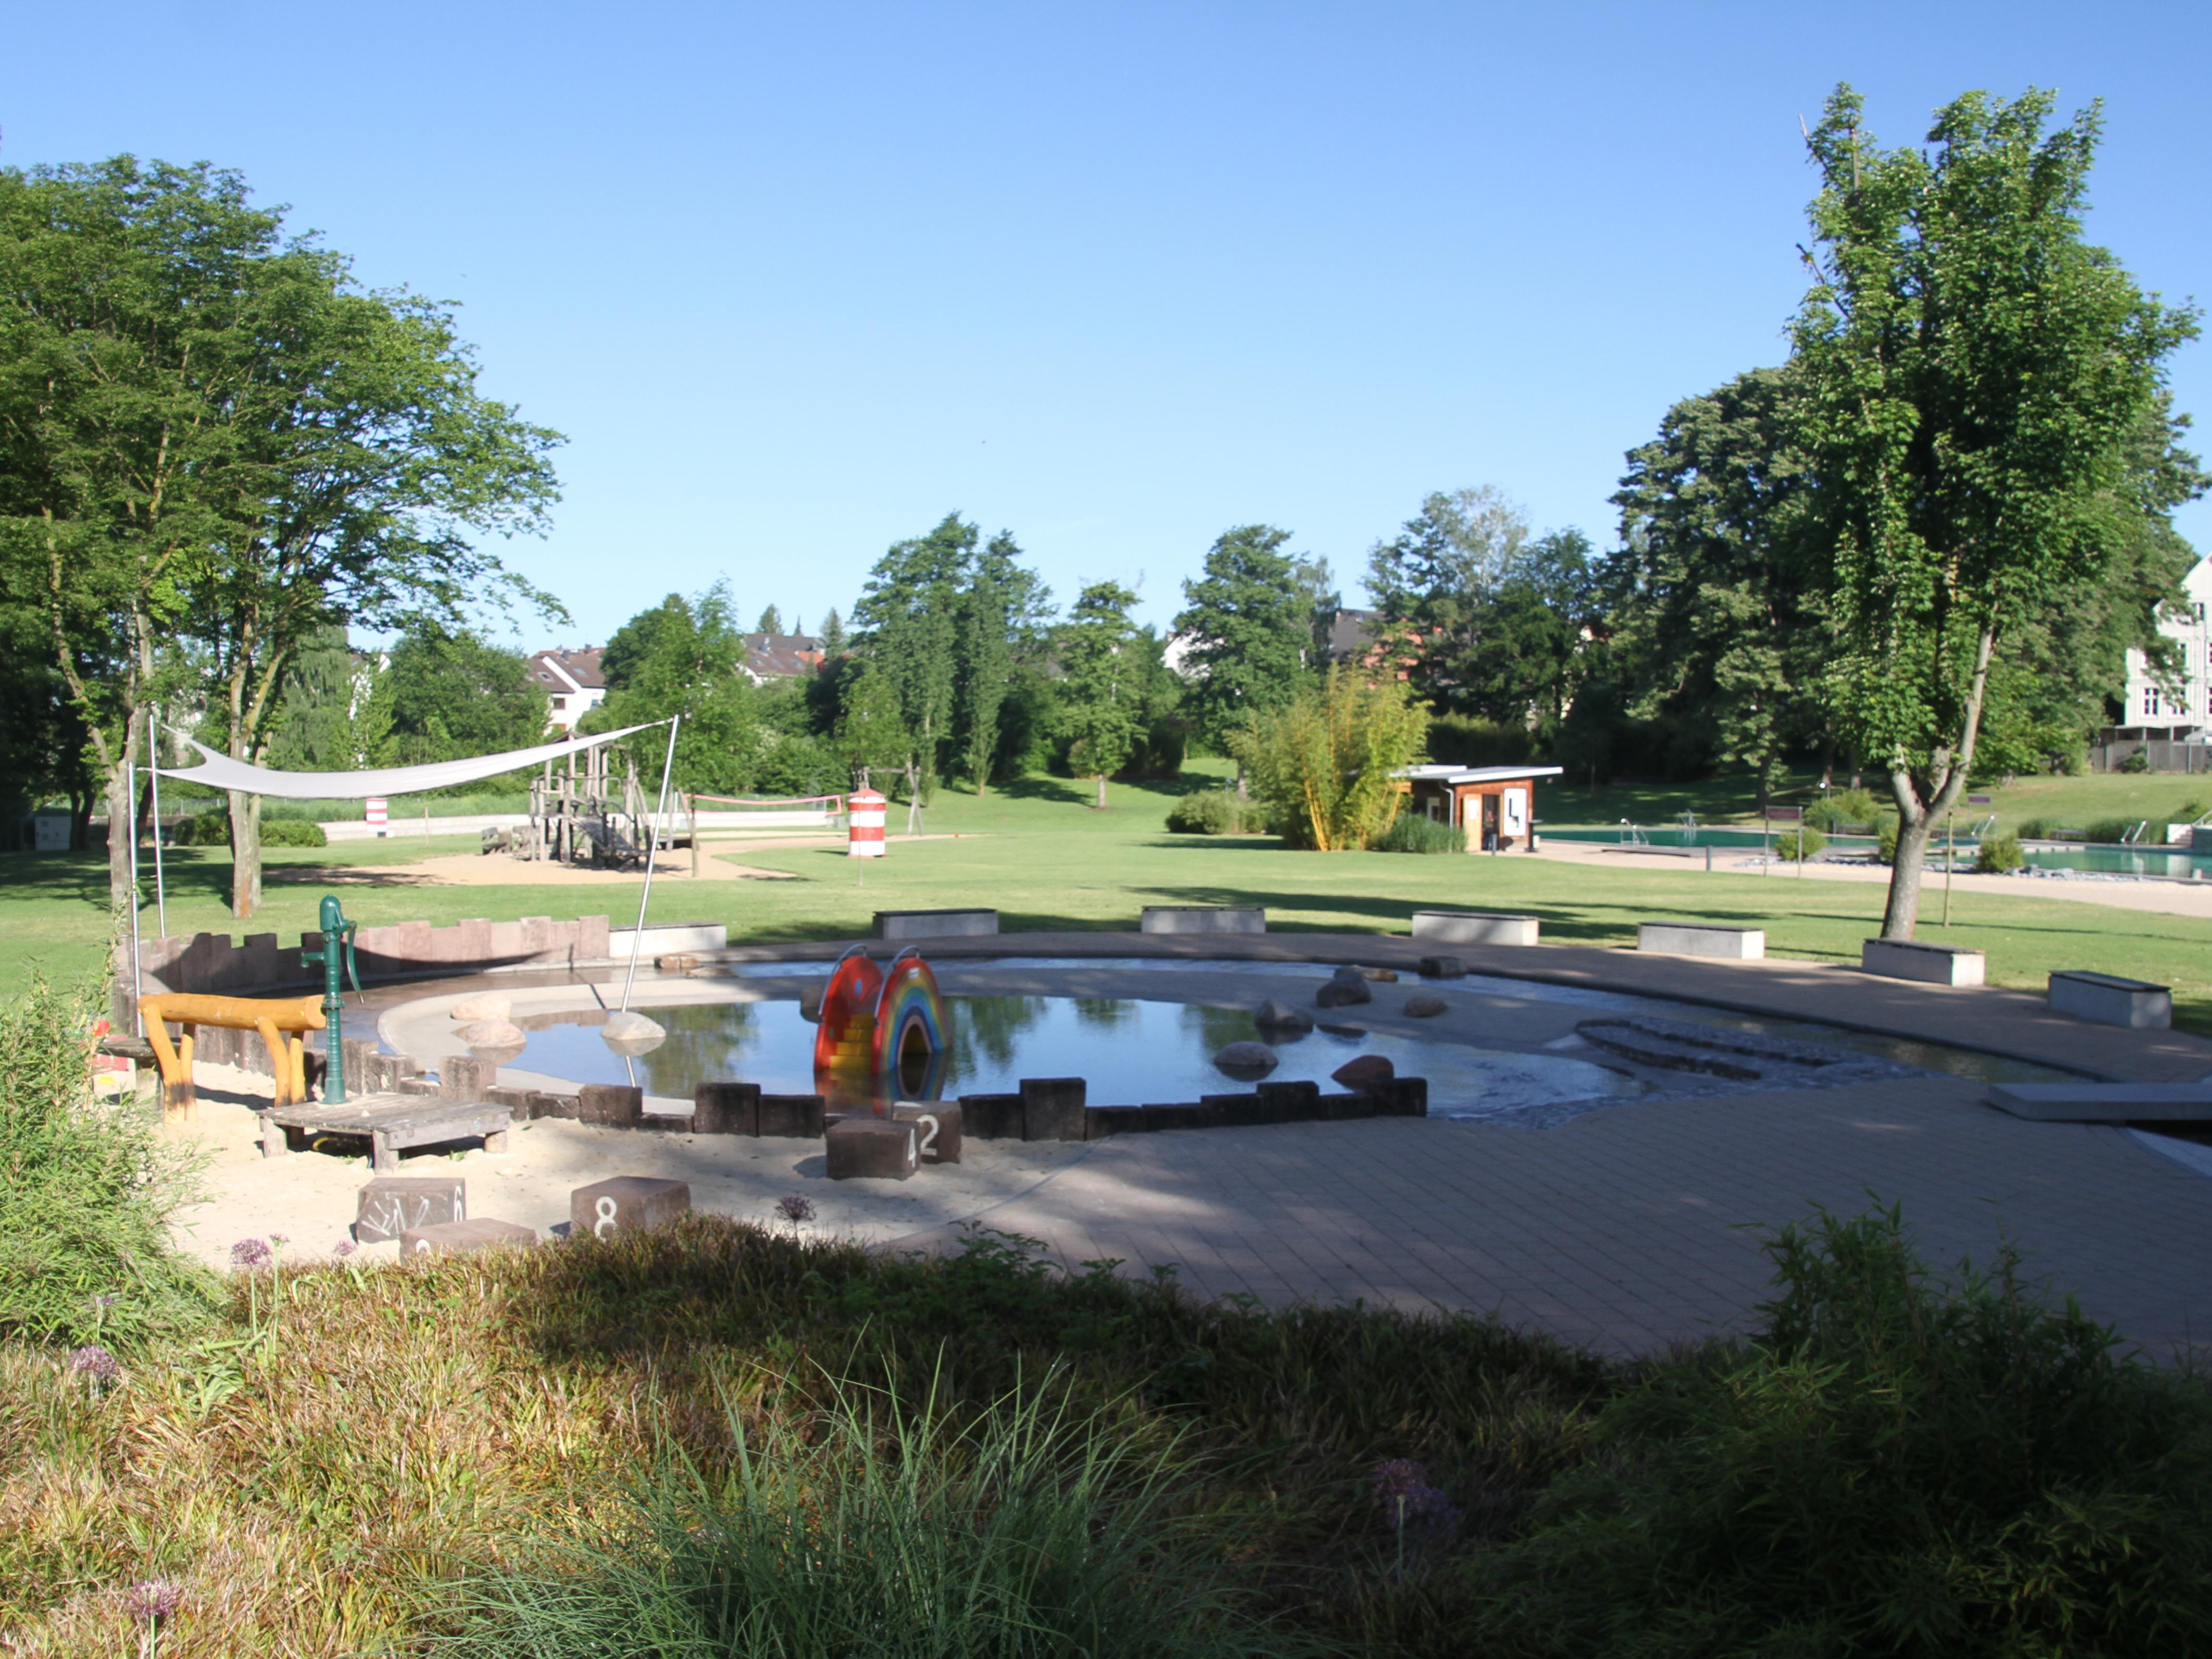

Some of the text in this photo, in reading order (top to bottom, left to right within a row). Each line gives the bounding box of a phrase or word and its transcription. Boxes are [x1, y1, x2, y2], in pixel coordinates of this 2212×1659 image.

[908, 1129, 917, 1168] 4
[917, 1115, 938, 1156] 2
[595, 1196, 617, 1244] 8
